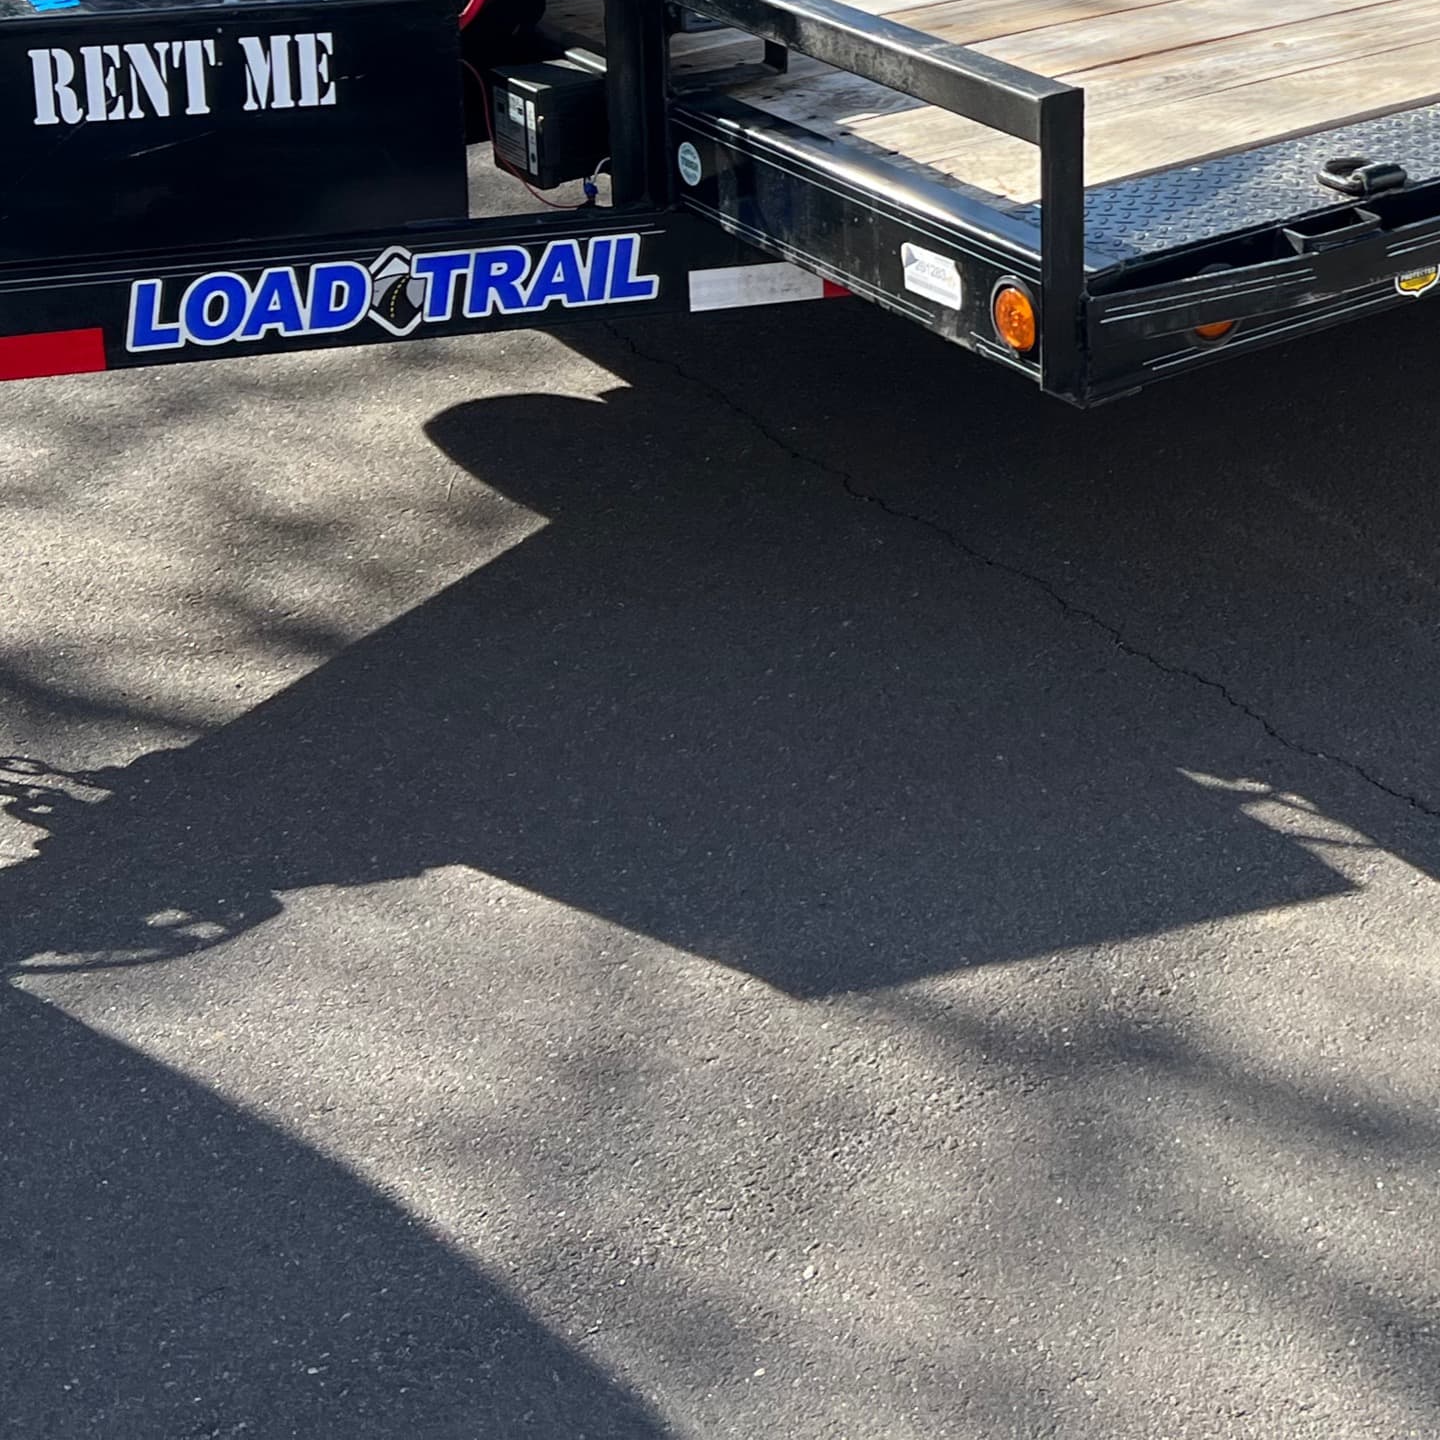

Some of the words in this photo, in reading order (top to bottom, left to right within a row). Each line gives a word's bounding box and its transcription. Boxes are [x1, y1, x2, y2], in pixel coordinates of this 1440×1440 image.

[27, 39, 216, 125] RENT
[238, 32, 337, 111] ME
[126, 261, 373, 353] LOAD
[409, 233, 660, 322] TRAIL
